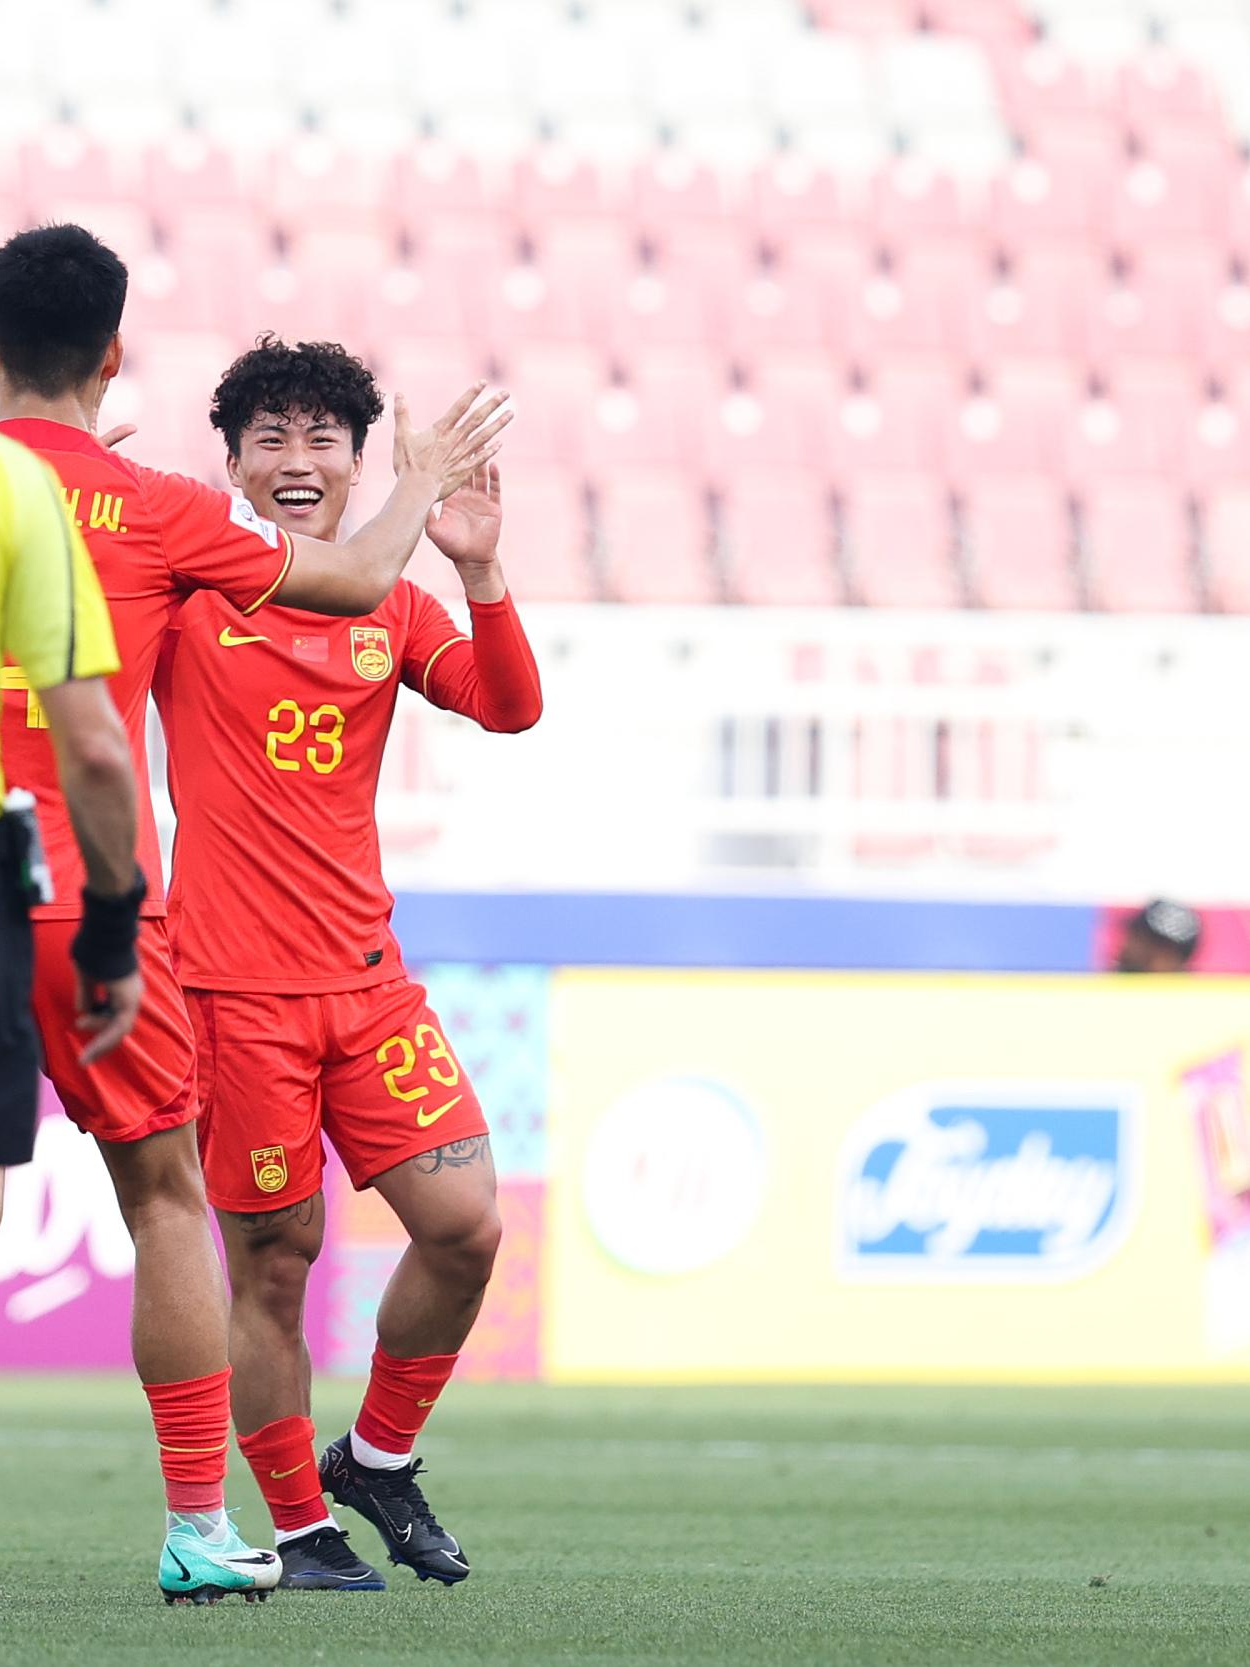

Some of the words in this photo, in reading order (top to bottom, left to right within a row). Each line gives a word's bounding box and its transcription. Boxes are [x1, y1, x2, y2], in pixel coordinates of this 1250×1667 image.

[353, 630, 385, 641] CFA
[265, 698, 346, 775] 23
[375, 1023, 459, 1103] 23
[254, 1149, 281, 1161] CFA
